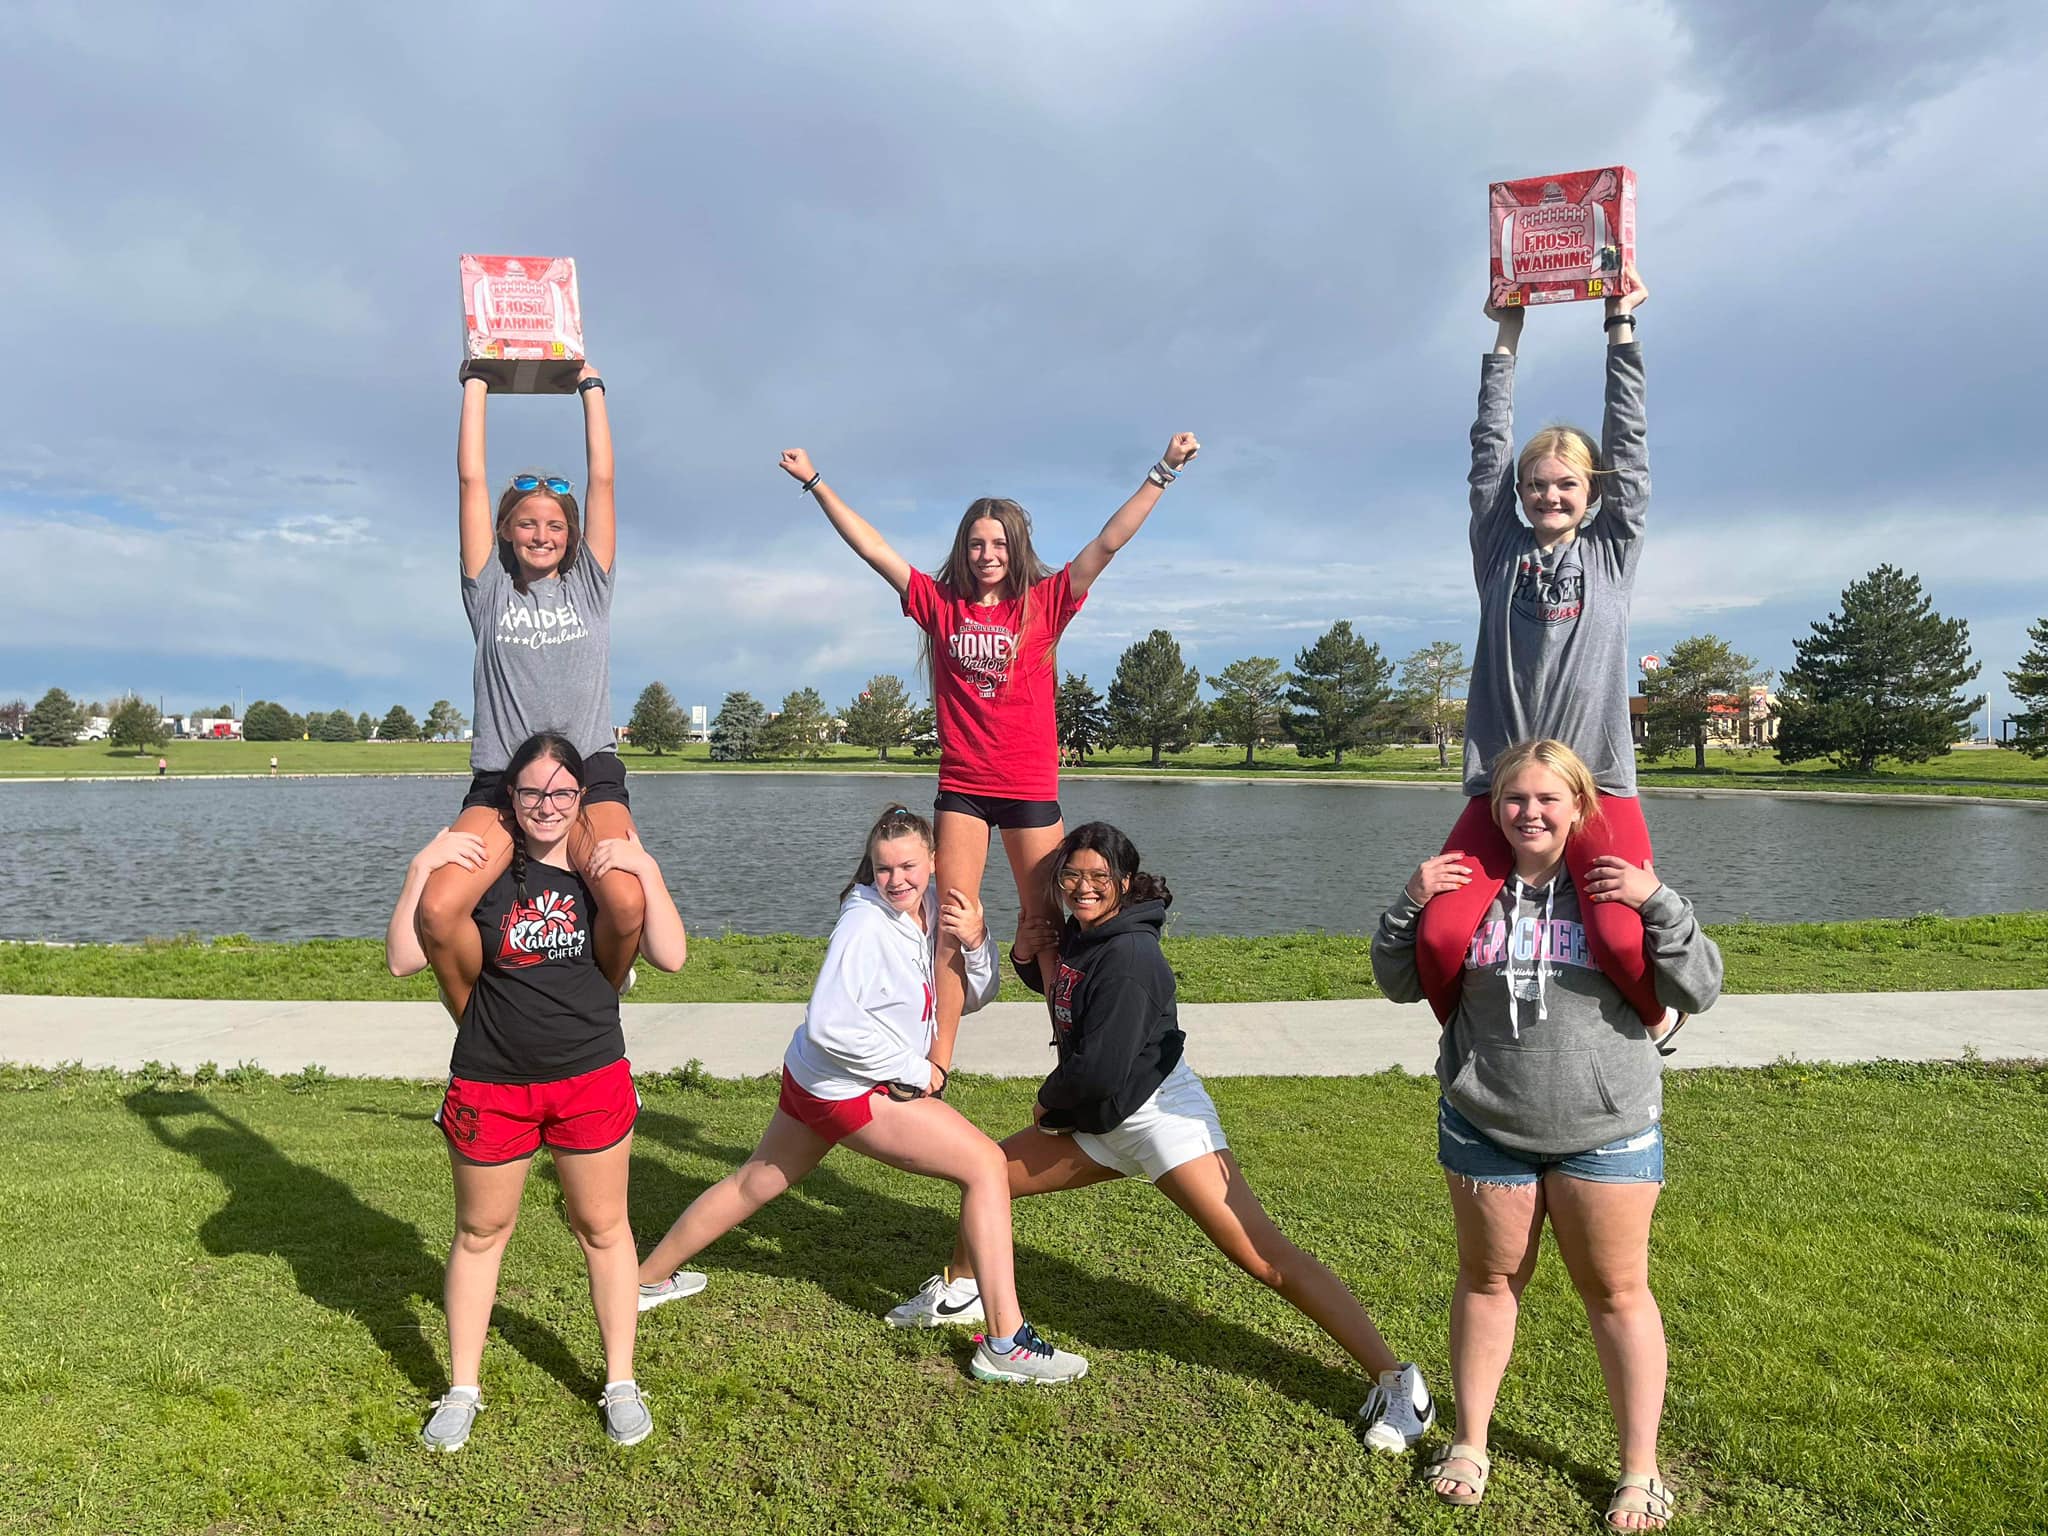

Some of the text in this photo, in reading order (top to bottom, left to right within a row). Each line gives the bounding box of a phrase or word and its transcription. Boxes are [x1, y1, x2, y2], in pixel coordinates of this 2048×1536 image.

[1523, 226, 1584, 252] FROST
[1513, 246, 1593, 274] WARNING
[1588, 279, 1603, 292] 16
[494, 299, 545, 315] FROST
[487, 316, 554, 330] WARNING
[949, 633, 1018, 660] SIDNEY
[960, 656, 1009, 673] Raiders
[509, 923, 586, 953] Raiders
[548, 945, 583, 960] CHEER
